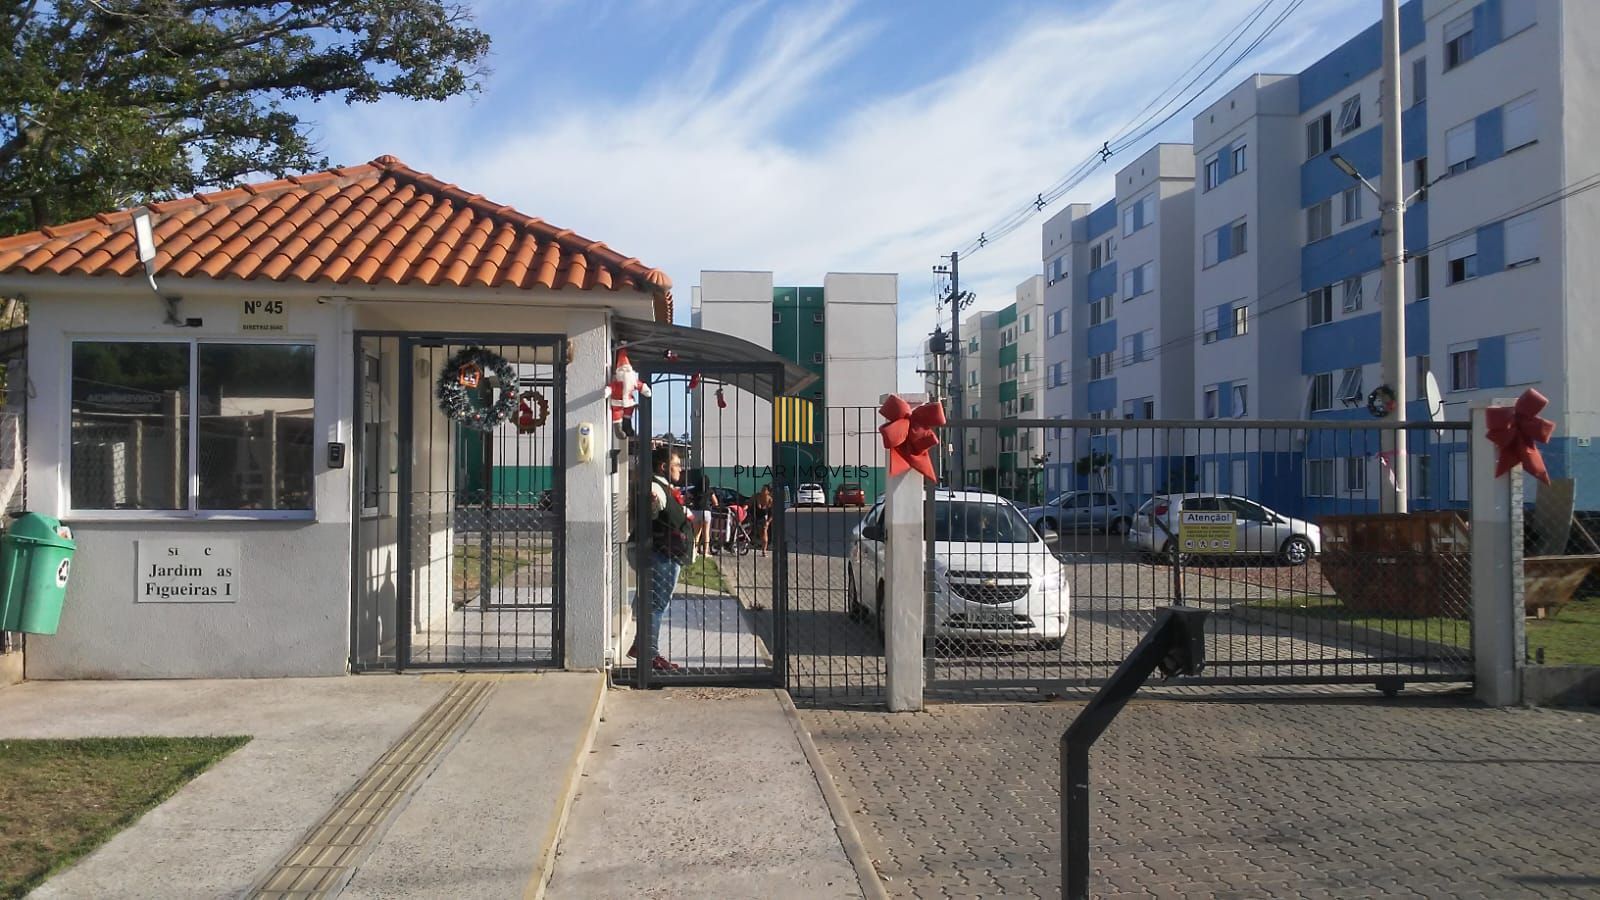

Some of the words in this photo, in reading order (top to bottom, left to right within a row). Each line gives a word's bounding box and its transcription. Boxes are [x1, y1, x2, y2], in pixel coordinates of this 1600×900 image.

[264, 300, 283, 314] 45
[1187, 513, 1230, 522] Atenção!
[149, 564, 202, 578] Jardim
[217, 567, 232, 577] as
[146, 582, 217, 599] Figueiras
[224, 583, 232, 596] I
